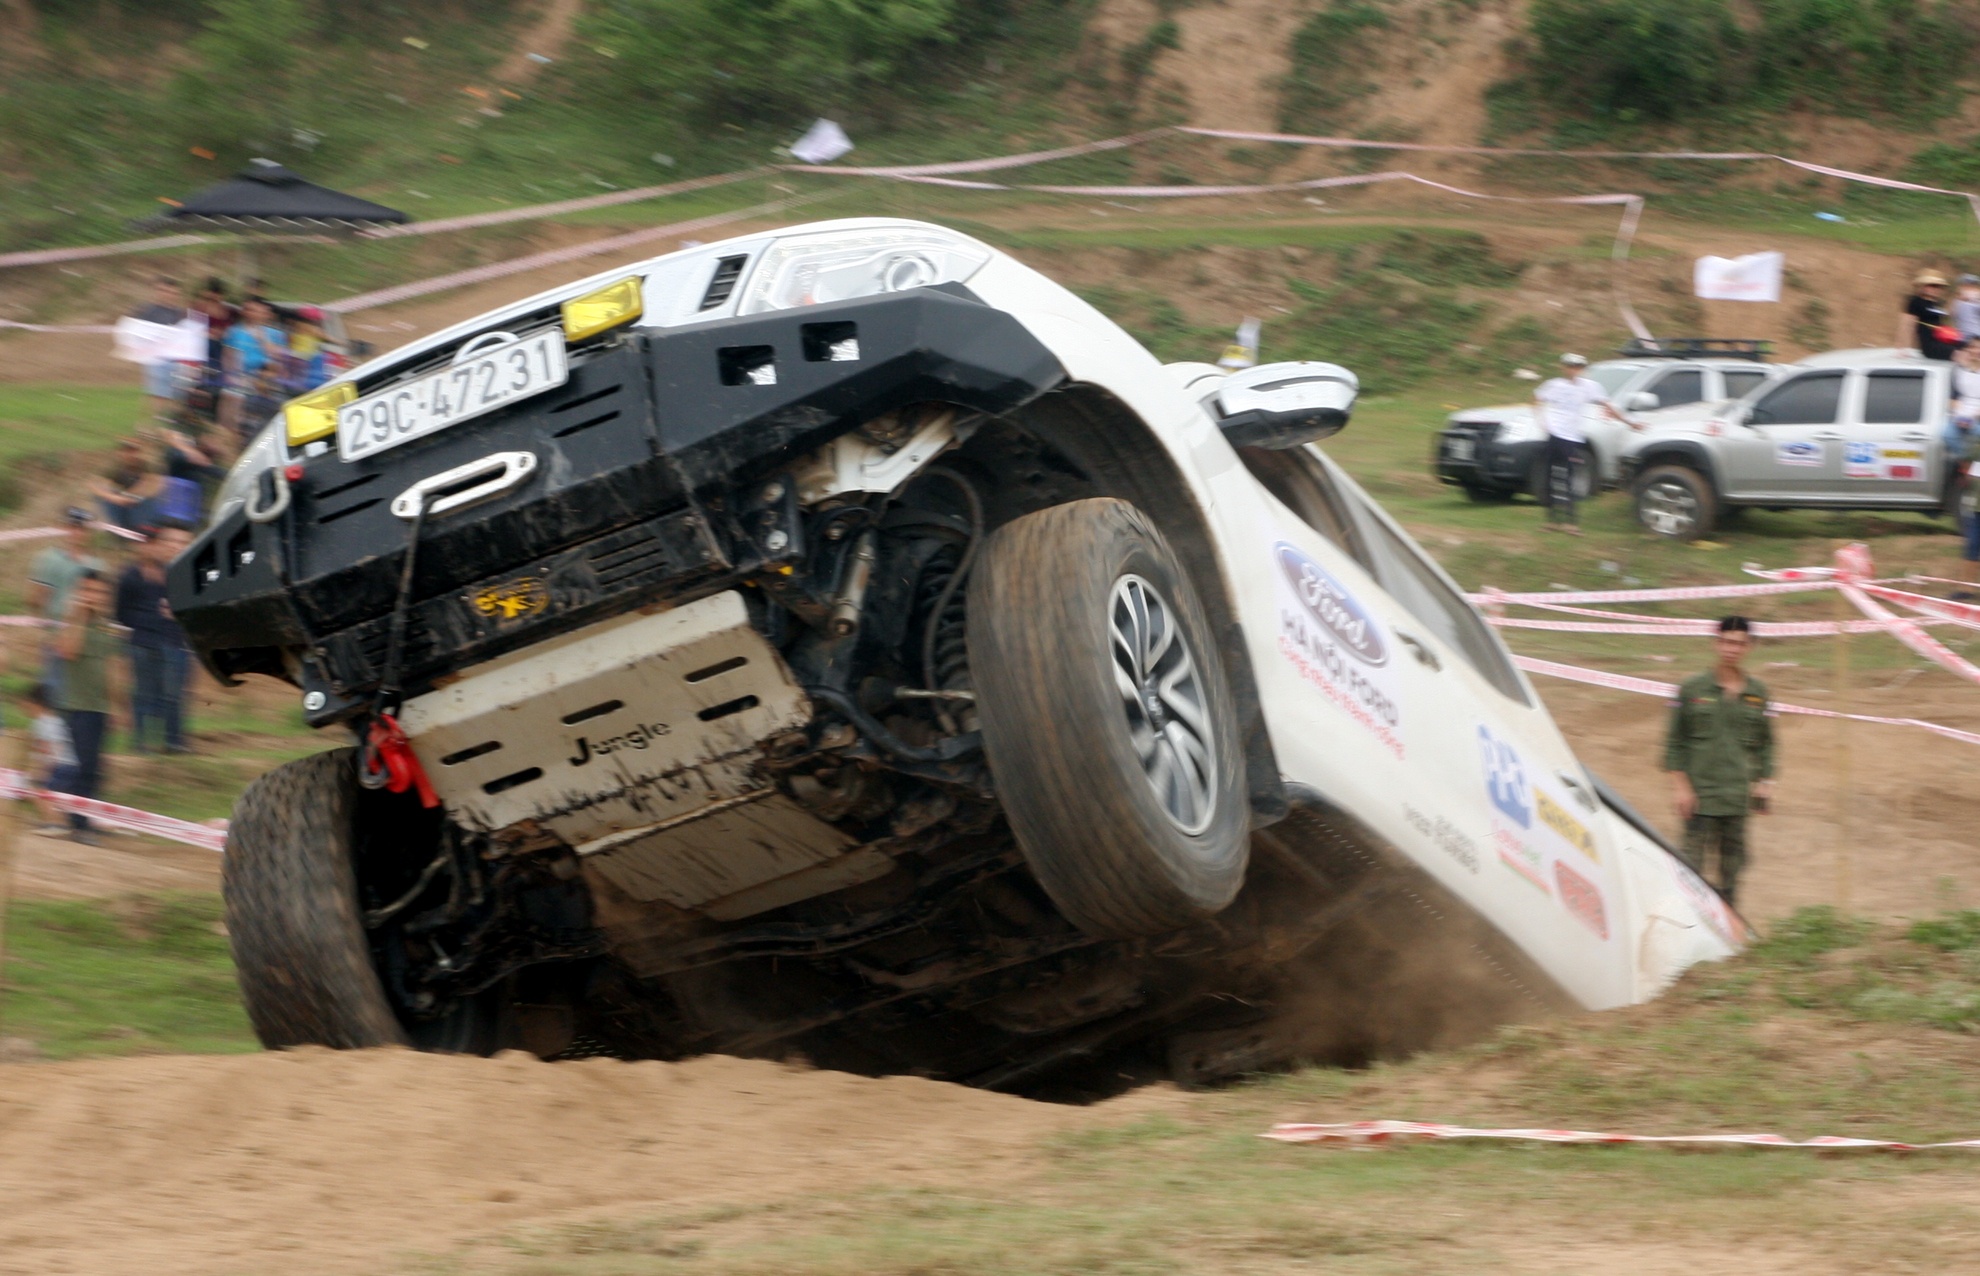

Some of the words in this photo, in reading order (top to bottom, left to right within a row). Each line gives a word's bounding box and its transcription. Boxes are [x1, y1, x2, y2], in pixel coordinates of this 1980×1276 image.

[1297, 561, 1370, 651] Ford
[1348, 667, 1400, 727] FORD
[567, 722, 673, 768] Jungle
